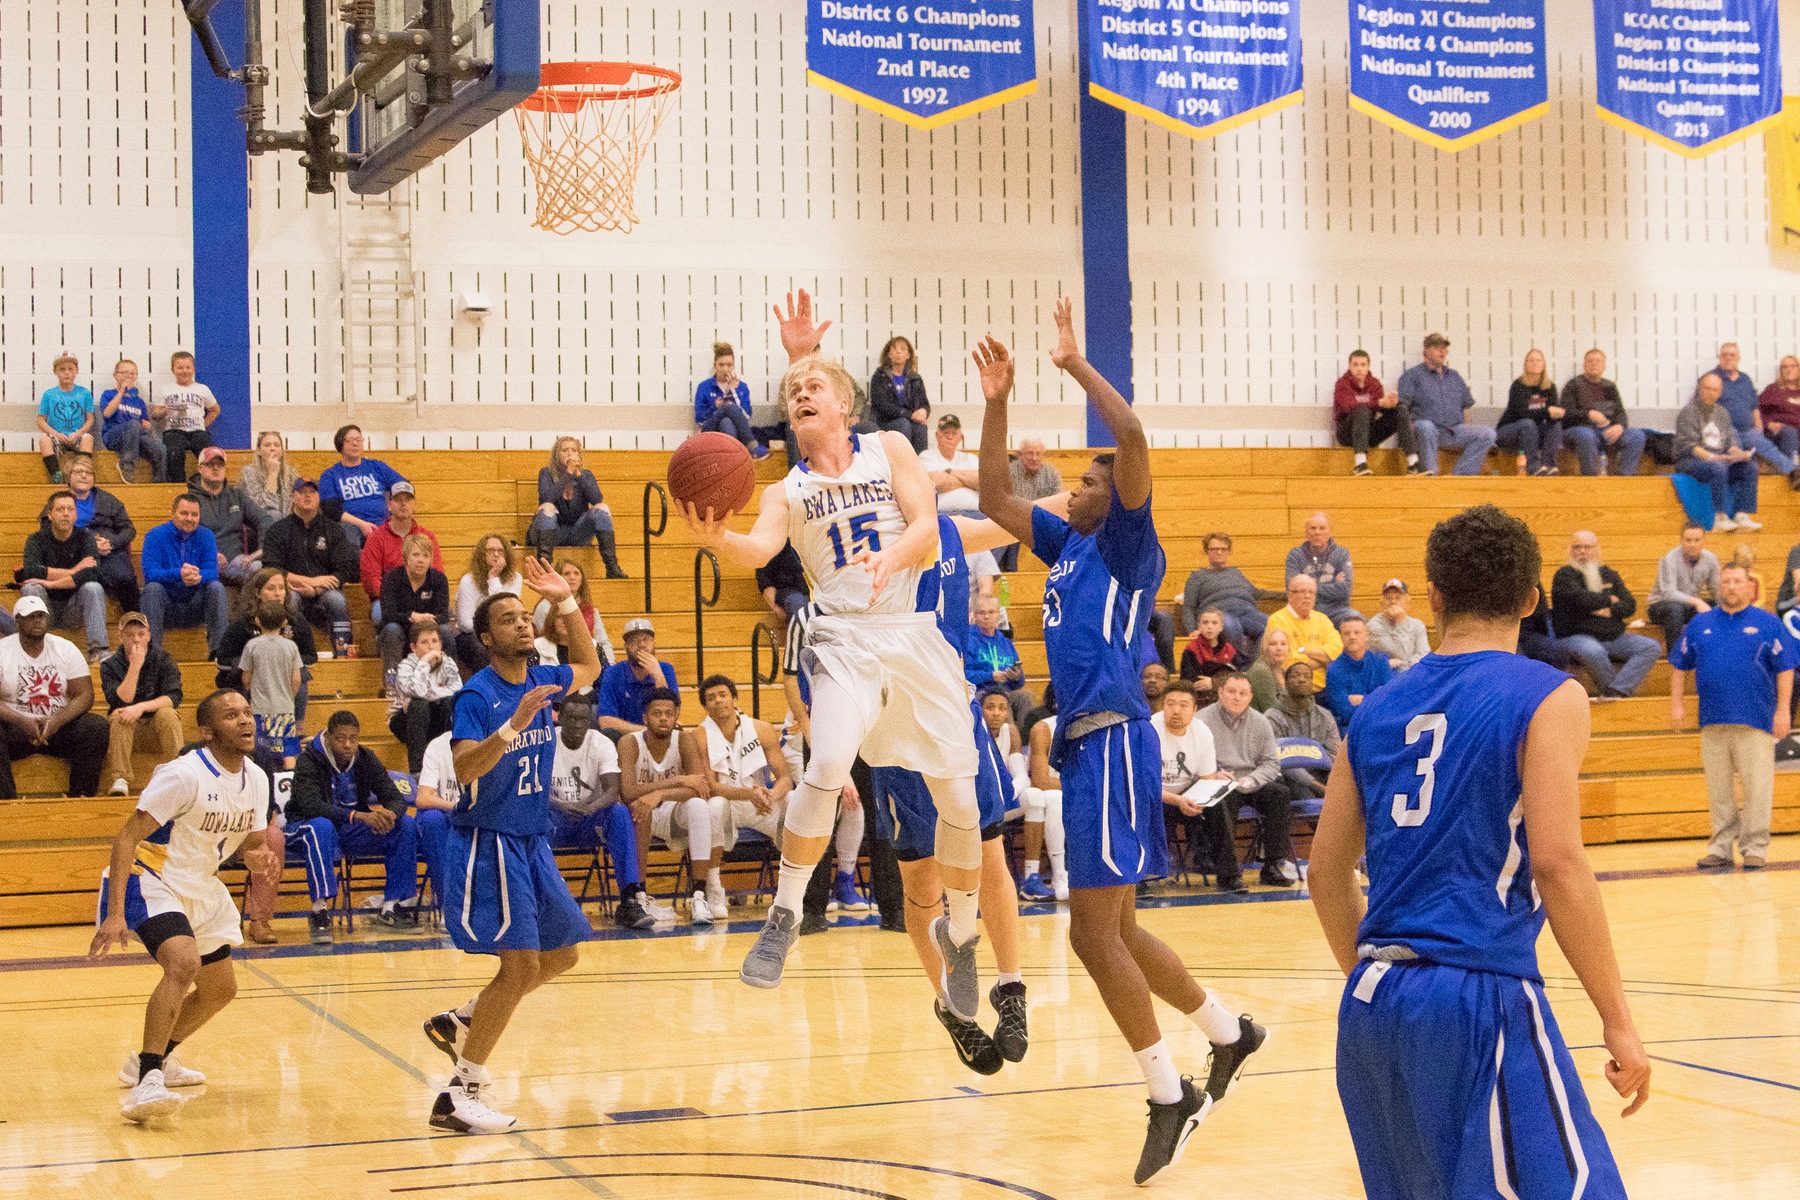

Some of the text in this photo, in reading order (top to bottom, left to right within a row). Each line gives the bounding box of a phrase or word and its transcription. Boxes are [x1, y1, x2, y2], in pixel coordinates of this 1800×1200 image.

[821, 1, 1020, 30] District 6 Champions
[1191, 0, 1290, 17] Champions
[1358, 4, 1536, 33] Region XI Champions
[1101, 16, 1288, 43] District 5 Champions
[1623, 12, 1750, 35] ICCAC Champions
[822, 28, 1022, 54] National Tournament
[1360, 29, 1534, 58] District 4 Champions
[1613, 32, 1663, 52] Region
[1684, 37, 1760, 57] Champions
[1102, 41, 1288, 66] National Tournament
[877, 58, 970, 79] 2nd Place
[1361, 53, 1535, 79] National Tournament
[1616, 54, 1667, 72] District
[1682, 58, 1760, 78] Champions
[1155, 70, 1239, 91] 4th Place
[1617, 76, 1760, 96] National Tournament
[902, 87, 949, 105] 1992
[1407, 84, 1490, 105] Qualifiers
[1177, 98, 1221, 116] 1994
[1656, 99, 1726, 118] Qualifiers
[1428, 110, 1472, 129] 2000
[1674, 122, 1709, 138] 2013
[339, 473, 379, 489] LOYAL
[343, 482, 383, 500] BLUE
[827, 512, 881, 569] 15
[518, 754, 543, 796] 21
[1391, 713, 1448, 827] 3
